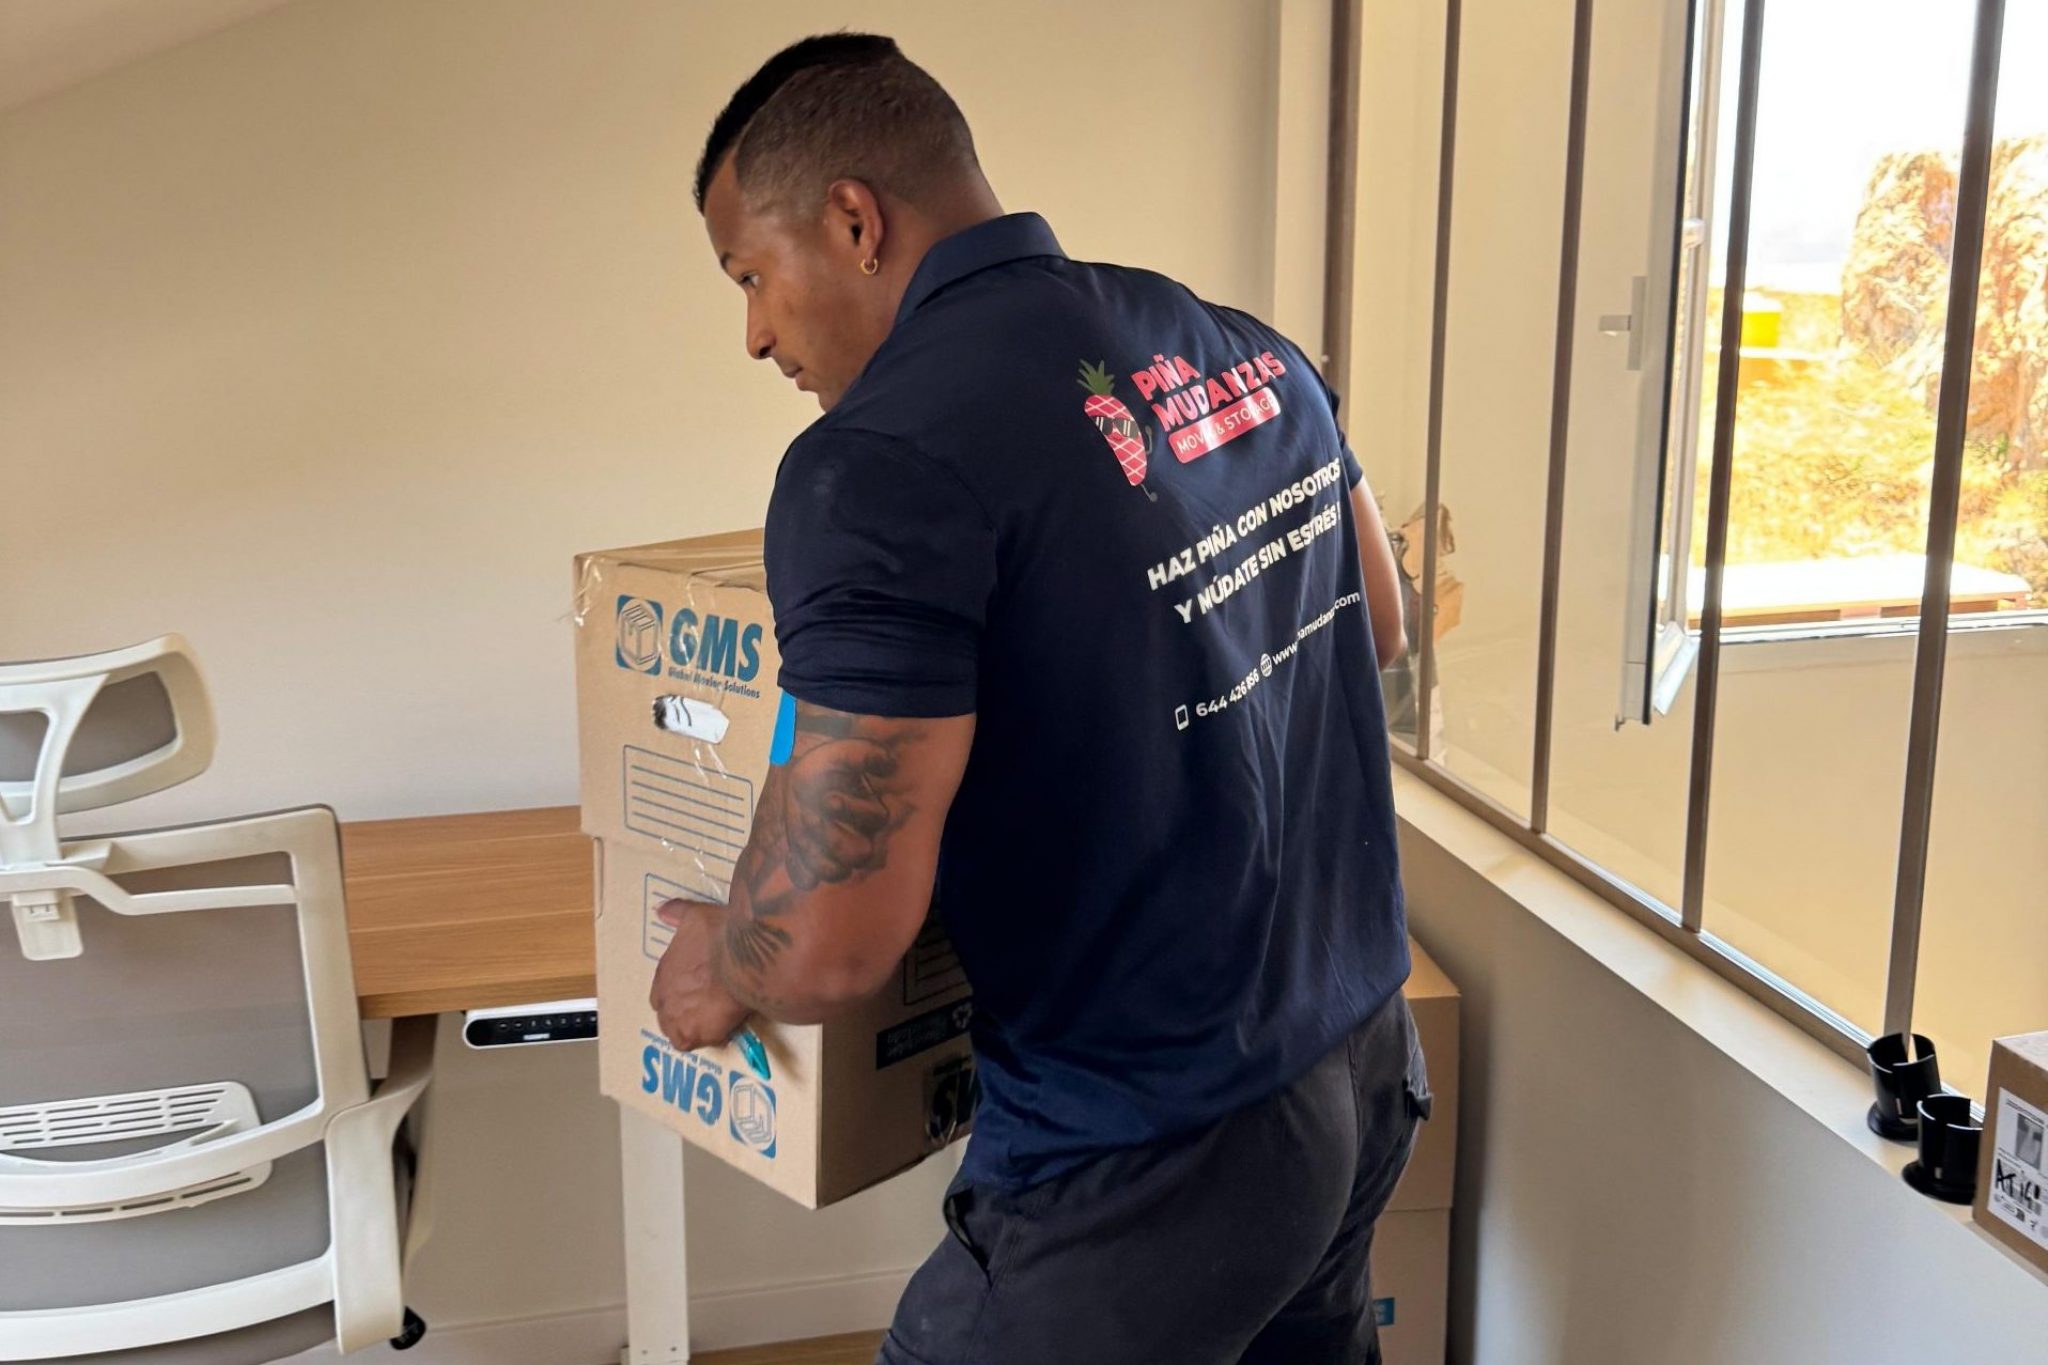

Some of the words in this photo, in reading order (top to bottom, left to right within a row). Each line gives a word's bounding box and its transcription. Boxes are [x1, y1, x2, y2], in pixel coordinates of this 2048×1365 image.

[1131, 353, 1201, 400] PIÑA
[1150, 351, 1287, 432] MUDANZAS
[1175, 425, 1212, 455] MOV
[1147, 547, 1196, 591] HAZ
[1196, 523, 1238, 564] PIÑA
[1237, 502, 1268, 538] CON
[1269, 457, 1341, 517] NOSOTROS
[1173, 598, 1193, 624] Y
[1197, 556, 1260, 615] MÚDATE
[1260, 537, 1287, 570] SIN
[669, 607, 763, 683] GMS
[1195, 695, 1228, 717] 644
[1229, 682, 1247, 703] 426
[641, 1044, 723, 1126] GMS
